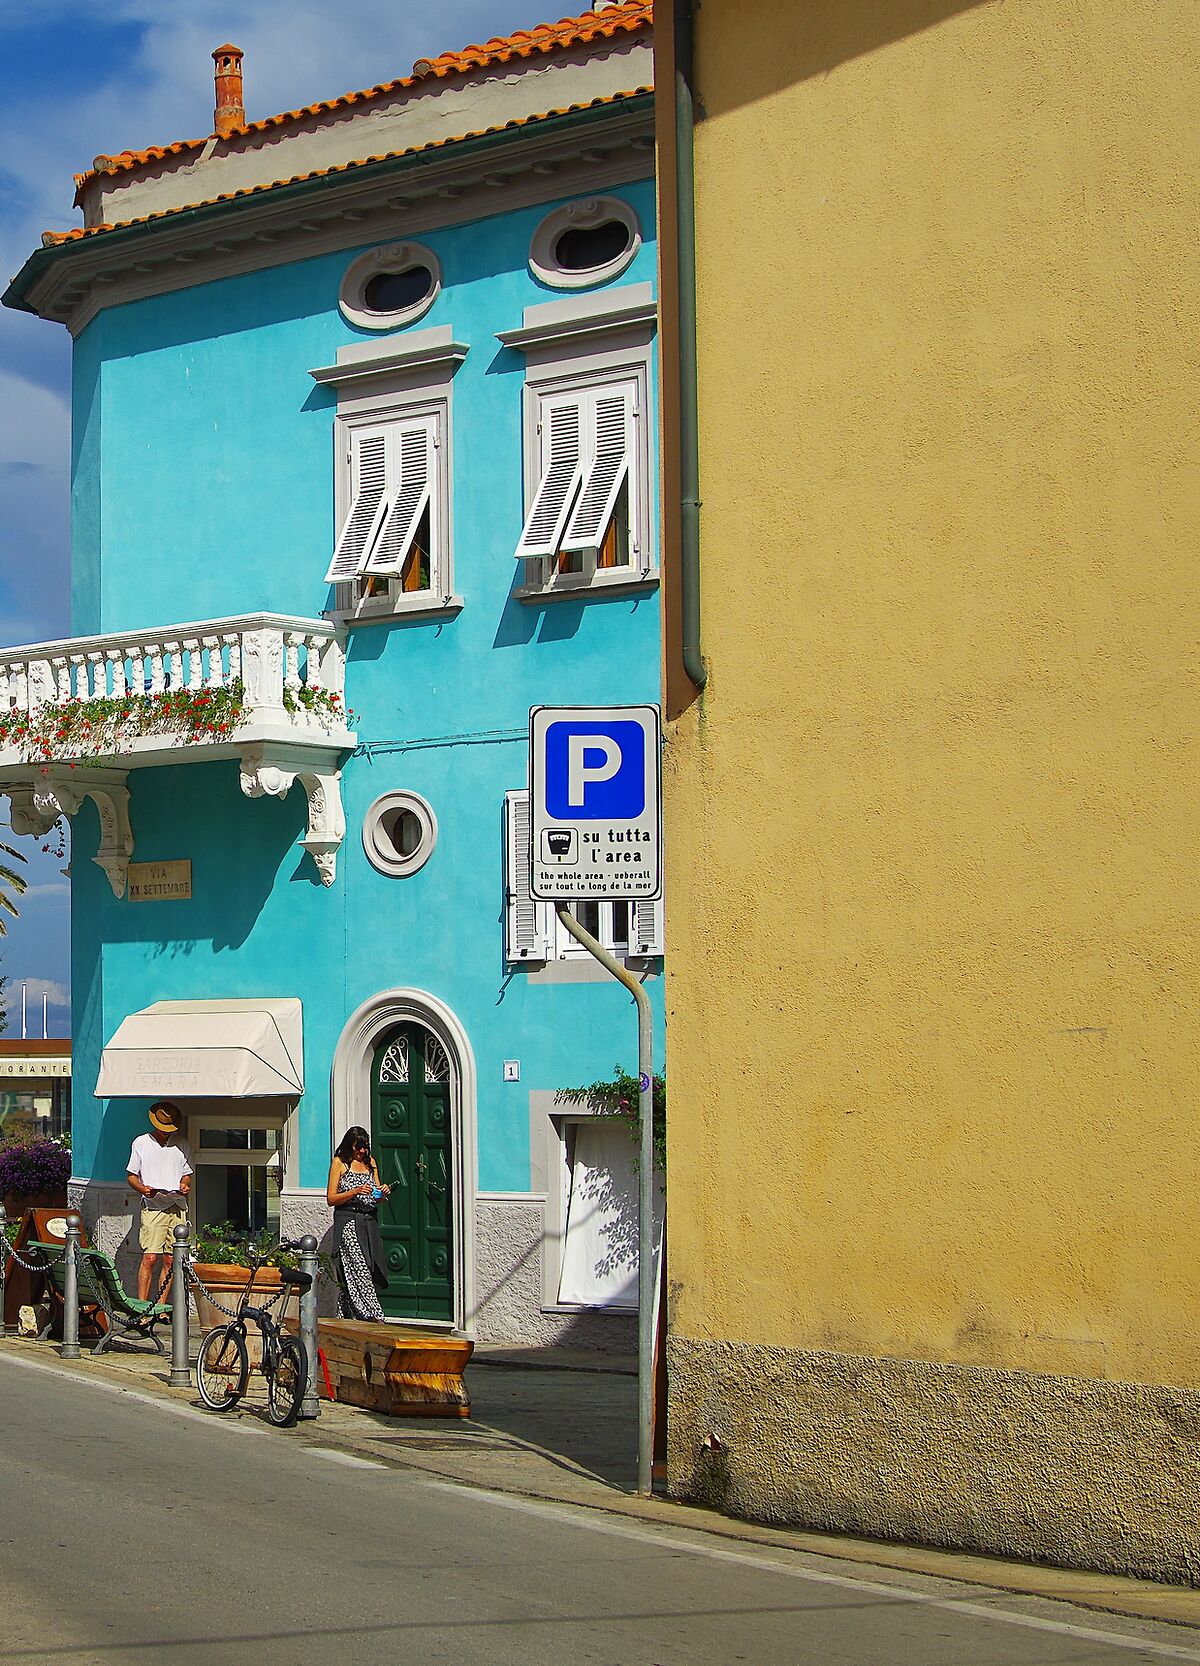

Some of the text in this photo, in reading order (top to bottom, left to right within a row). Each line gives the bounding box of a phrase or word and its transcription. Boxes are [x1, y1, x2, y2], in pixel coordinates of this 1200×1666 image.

[568, 734, 623, 807] P
[582, 829, 651, 843] su tutta
[591, 849, 642, 863] l'area
[150, 867, 167, 879] VIA
[540, 871, 554, 880] the
[557, 871, 582, 880] whole
[584, 872, 604, 880] area
[614, 870, 651, 880] ueberall
[539, 881, 652, 892] sur tout le long de la mer
[136, 1057, 201, 1071] SARTORIA
[509, 1066, 513, 1076] 1
